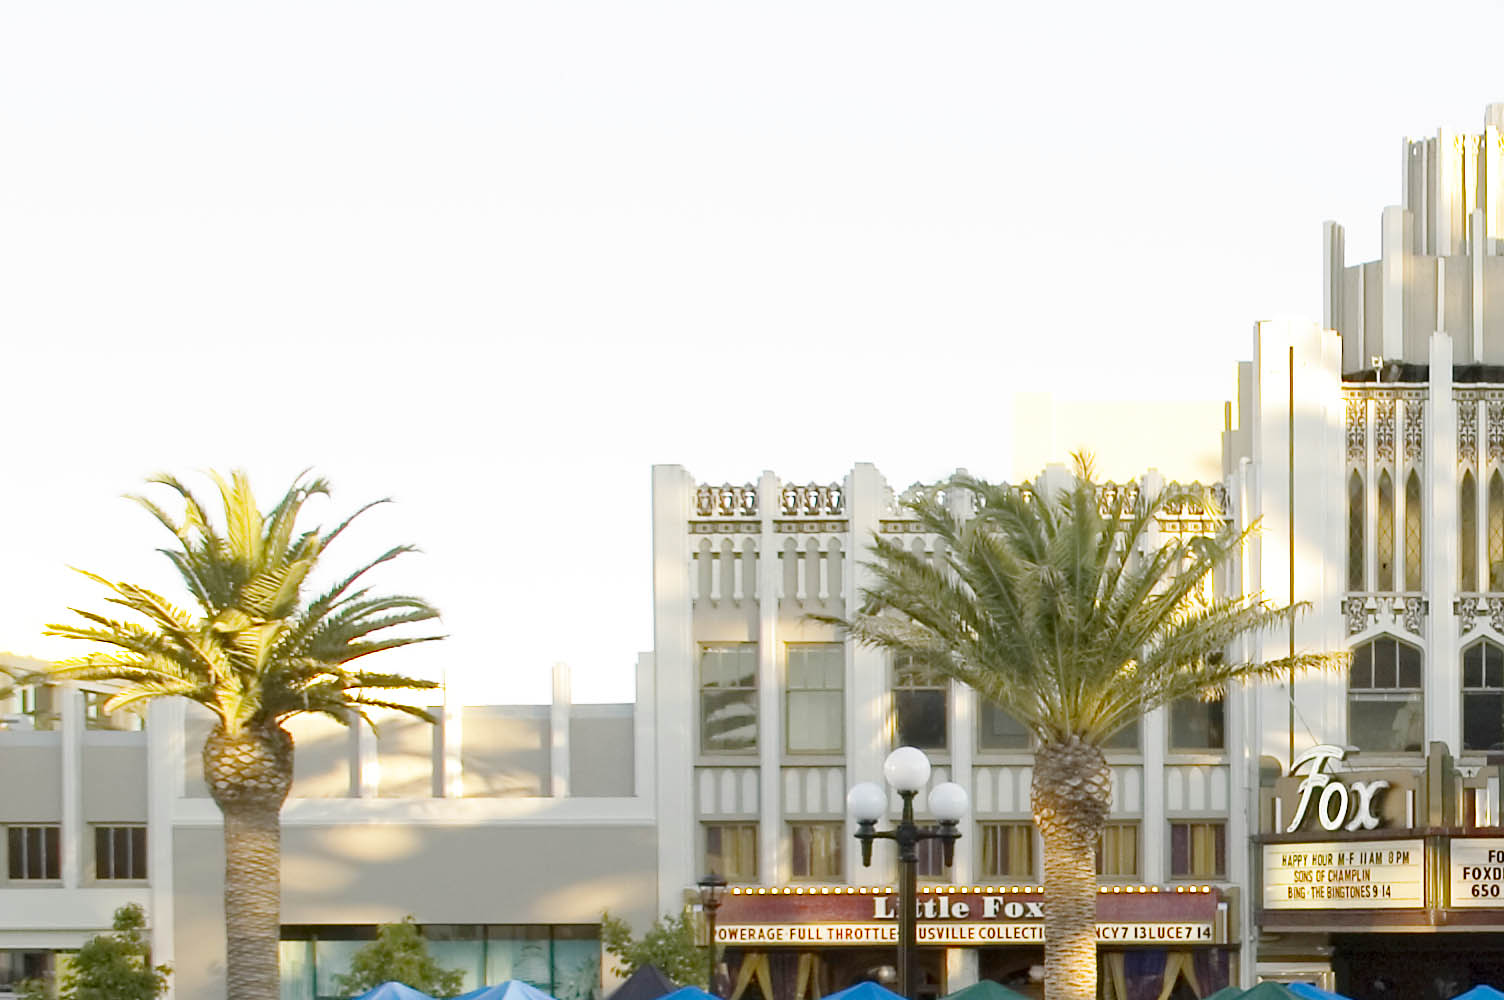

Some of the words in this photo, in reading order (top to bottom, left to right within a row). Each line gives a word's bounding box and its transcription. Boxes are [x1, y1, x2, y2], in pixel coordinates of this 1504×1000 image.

[1287, 745, 1390, 832] Fox
[1282, 853, 1308, 867] HAPPY
[1312, 853, 1333, 866] HOUR
[1294, 870, 1313, 883] SONS
[1316, 870, 1325, 883] OF
[1328, 869, 1371, 883] CHAMPLIN
[1327, 885, 1371, 899] BINGTONES
[1471, 884, 1500, 897] 650
[873, 896, 970, 919] Lttle
[982, 896, 1045, 919] Fox
[790, 928, 823, 940] FULL
[918, 927, 975, 940] USVILLE
[978, 927, 1045, 940] COLLECTI
